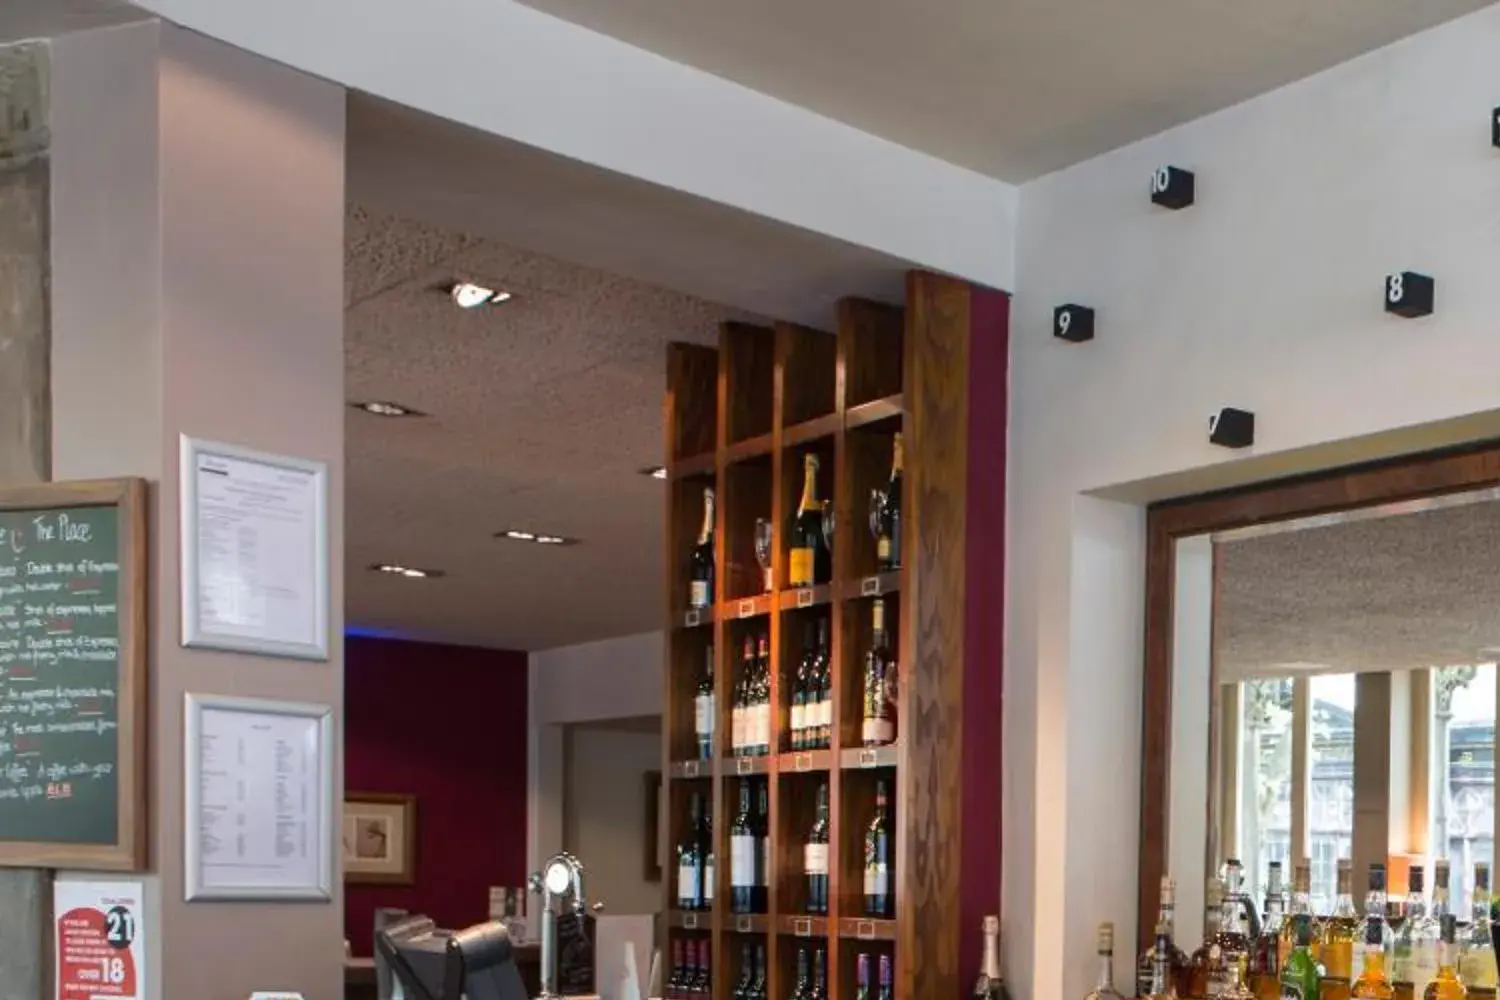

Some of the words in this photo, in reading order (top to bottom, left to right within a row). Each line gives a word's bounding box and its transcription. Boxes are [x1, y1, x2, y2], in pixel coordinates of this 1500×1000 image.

[1151, 165, 1169, 193] 10
[1389, 274, 1403, 303] 8
[1059, 311, 1071, 335] 9
[32, 515, 55, 540] The
[59, 514, 92, 542] Place
[108, 912, 133, 941] 21
[101, 957, 124, 983] 18
